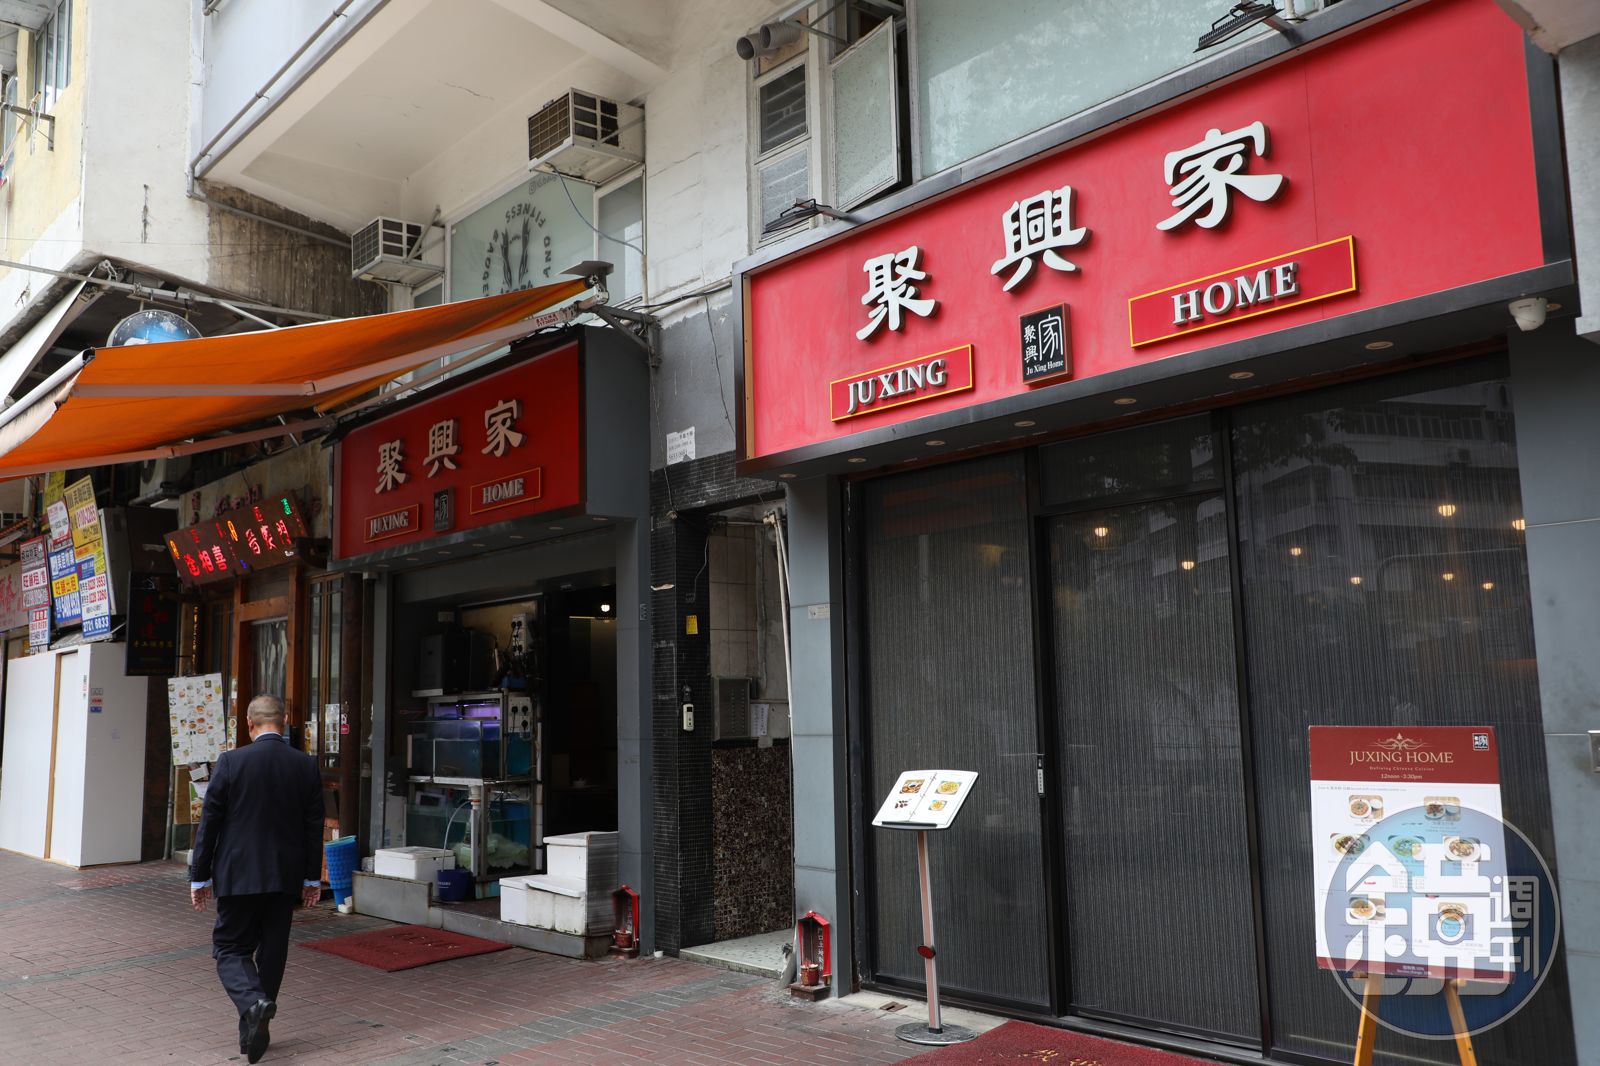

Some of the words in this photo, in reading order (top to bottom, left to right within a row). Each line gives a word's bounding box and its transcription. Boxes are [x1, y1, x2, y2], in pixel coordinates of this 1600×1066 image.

[505, 203, 546, 228] FITNESS
[855, 120, 1283, 341] 聚興家
[1171, 261, 1300, 326] HOME
[1023, 324, 1039, 364] 聚興
[1038, 313, 1064, 361] 家
[847, 359, 949, 414] JUXING
[1026, 366, 1034, 376] Ju
[1033, 363, 1047, 373] Xing
[1047, 360, 1064, 370] Home
[374, 399, 525, 495] 聚興家
[482, 477, 525, 504] HOME
[370, 511, 409, 537] JUXING
[1350, 751, 1402, 765] JUXING
[1406, 751, 1454, 764] HOME
